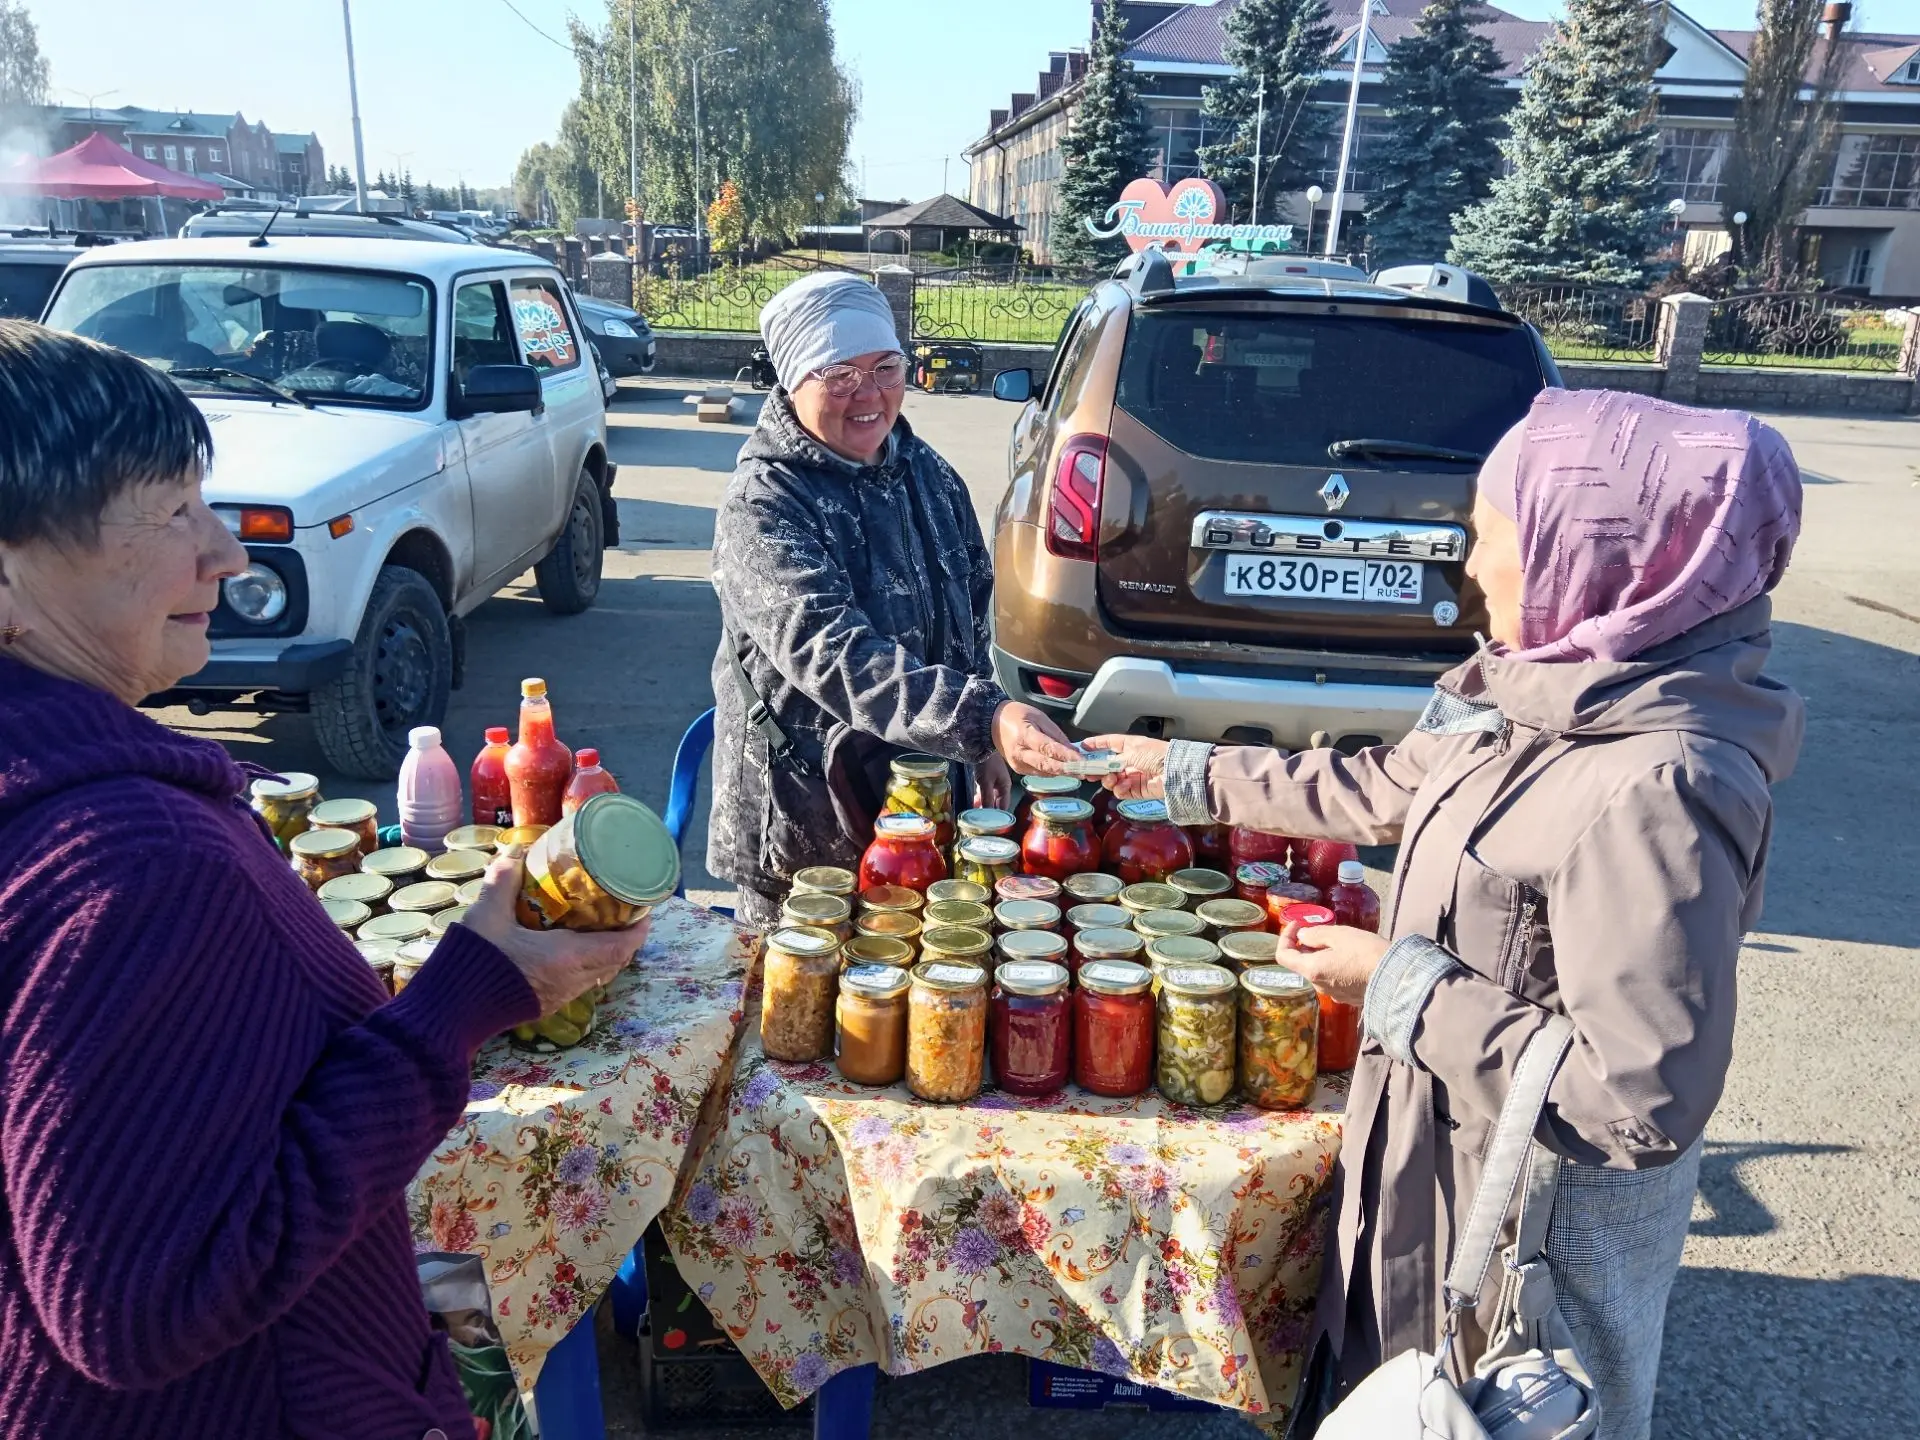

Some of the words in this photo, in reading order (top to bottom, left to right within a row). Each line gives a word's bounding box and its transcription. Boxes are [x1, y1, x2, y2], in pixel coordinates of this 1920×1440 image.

[1208, 529, 1455, 557] DUSTER
[1237, 560, 1360, 595] К830РЕ
[1367, 563, 1413, 589] 702
[1118, 580, 1177, 594] RENAULT
[1377, 588, 1399, 598] RUS
[1113, 1382, 1142, 1396] Atavita
